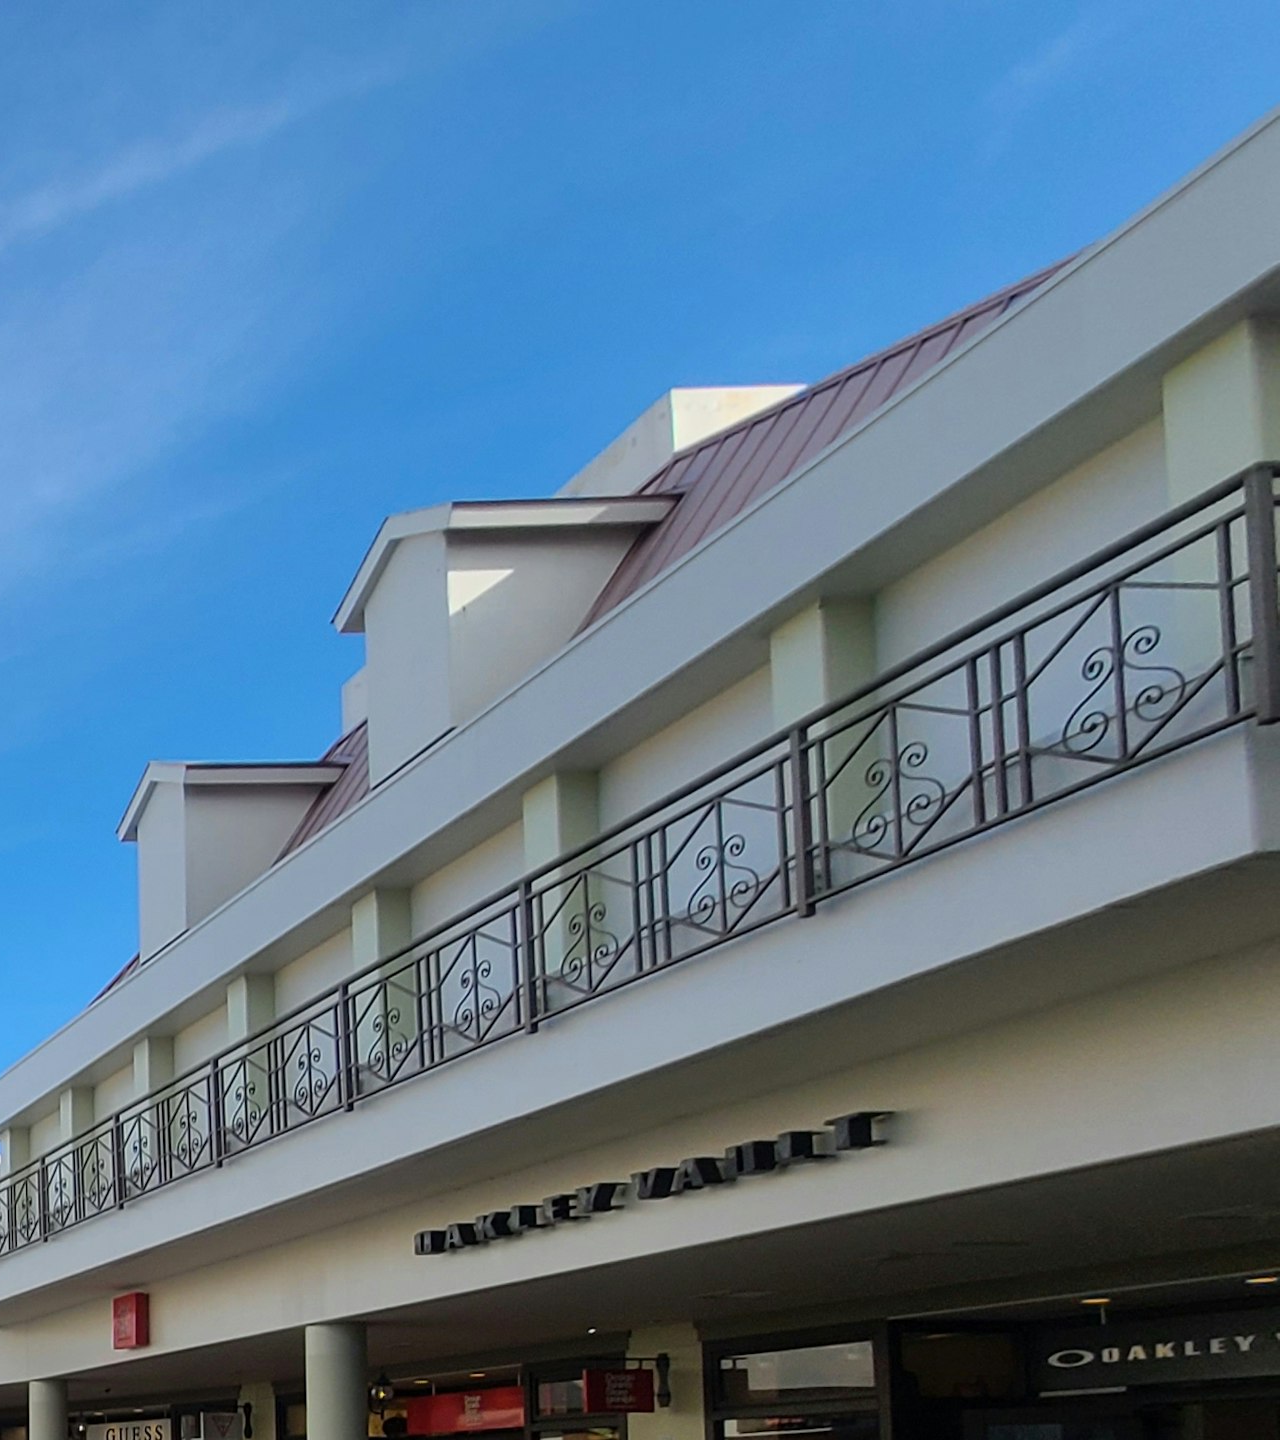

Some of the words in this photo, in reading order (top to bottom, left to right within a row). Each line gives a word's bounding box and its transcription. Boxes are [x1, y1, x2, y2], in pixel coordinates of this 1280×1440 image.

[414, 1181, 630, 1256] OAKLEY
[630, 1111, 898, 1200] VAULT
[1101, 1334, 1256, 1363] OAKLEY
